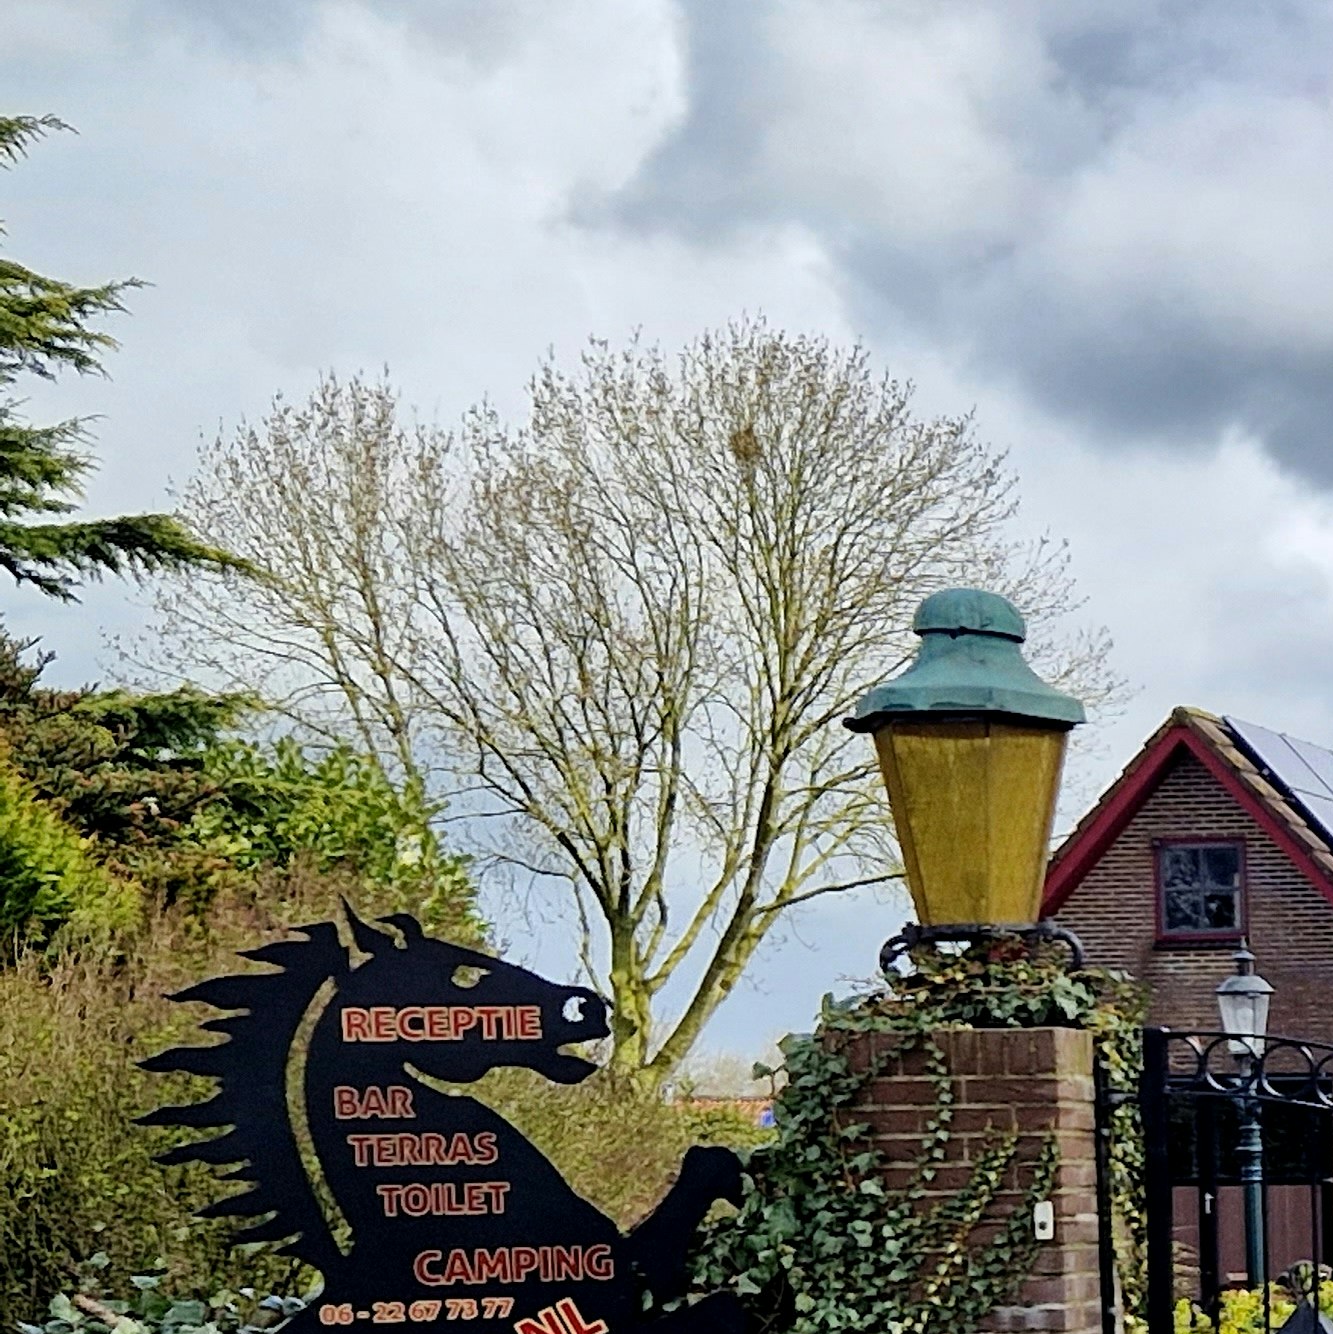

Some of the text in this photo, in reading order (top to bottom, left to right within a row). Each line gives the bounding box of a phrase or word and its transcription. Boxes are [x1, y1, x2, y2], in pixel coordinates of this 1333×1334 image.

[341, 1006, 542, 1042] RECEPTIE
[334, 1086, 416, 1119] BAR
[347, 1133, 498, 1166] TERRAS
[377, 1182, 510, 1217] TOILET
[413, 1244, 614, 1286] CAMPING
[319, 1303, 354, 1325] 06
[372, 1302, 406, 1323] 22
[409, 1300, 442, 1321] 67
[446, 1299, 478, 1320] 73
[481, 1297, 514, 1318] 77
